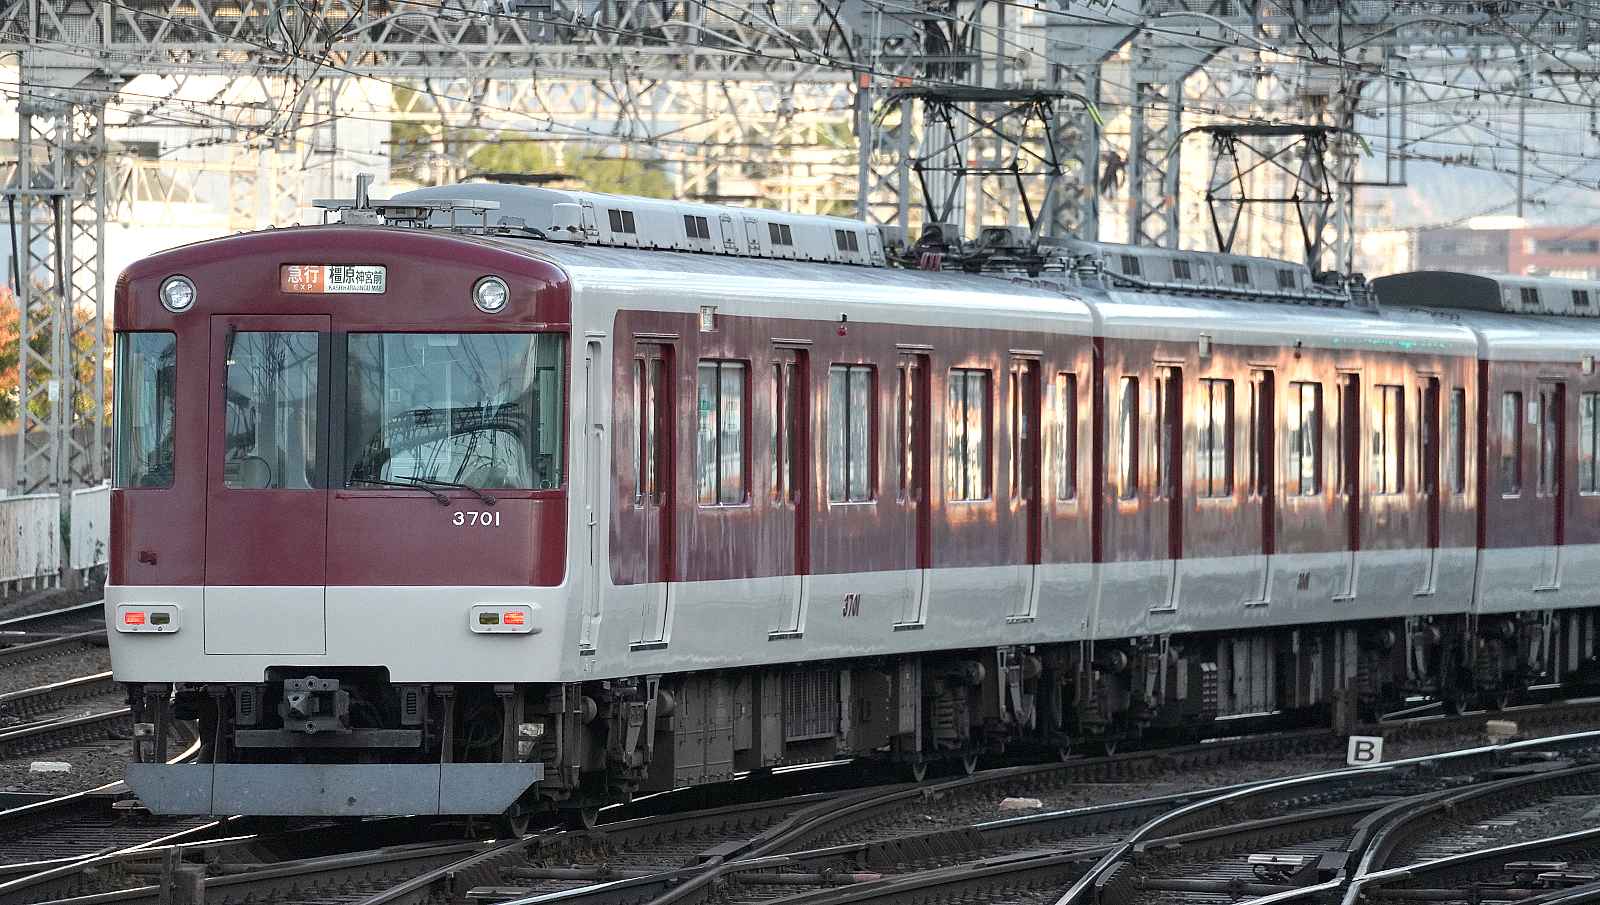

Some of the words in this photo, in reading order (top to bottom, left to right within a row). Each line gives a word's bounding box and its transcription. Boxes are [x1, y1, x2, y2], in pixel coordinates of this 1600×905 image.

[288, 265, 320, 283] 急行
[329, 265, 383, 284] 橿原神宮前
[452, 511, 500, 526] 3701
[842, 593, 861, 617] 3701
[1354, 741, 1375, 761] B
